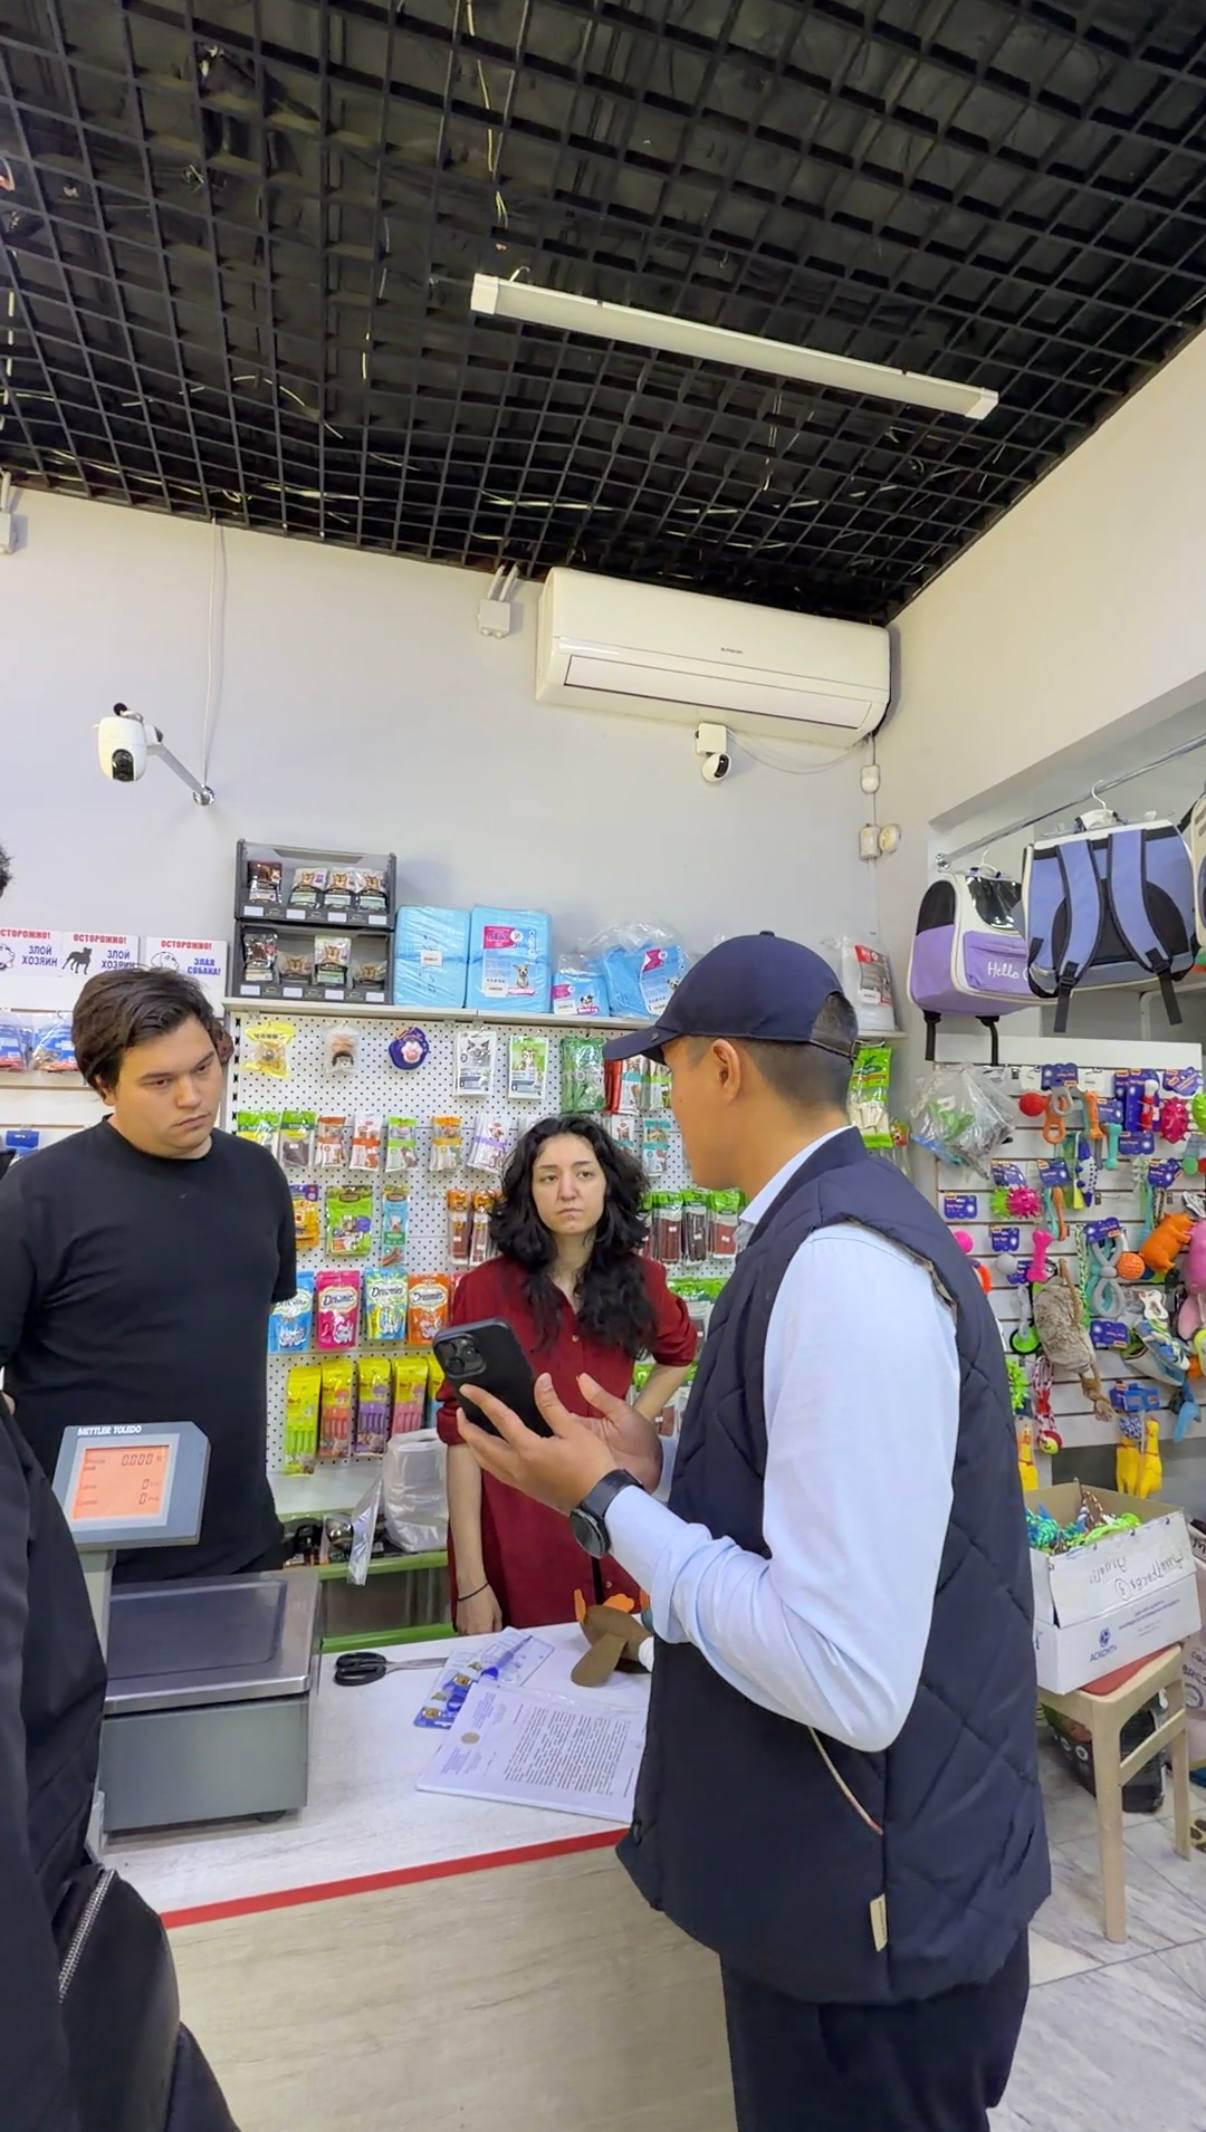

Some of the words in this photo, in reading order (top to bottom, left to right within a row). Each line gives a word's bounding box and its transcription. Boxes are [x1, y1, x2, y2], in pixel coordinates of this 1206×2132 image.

[0, 929, 51, 940] СТОРОЖНО!
[73, 934, 127, 945] ОСТОРОЖНО!
[28, 944, 52, 956] ЗЛОЙ
[161, 940, 212, 950] ОСТОРОЖНО!
[106, 948, 131, 960] ЗЛОЙ
[22, 955, 58, 967] ХОЗЯИН
[193, 957, 216, 967] ЗЛАЯ
[187, 966, 221, 976] СОБАКА!
[987, 961, 1020, 979] Hello
[77, 1426, 112, 1436] METTLER
[113, 1425, 142, 1434] TOLEDO
[121, 1453, 154, 1466] 0.000
